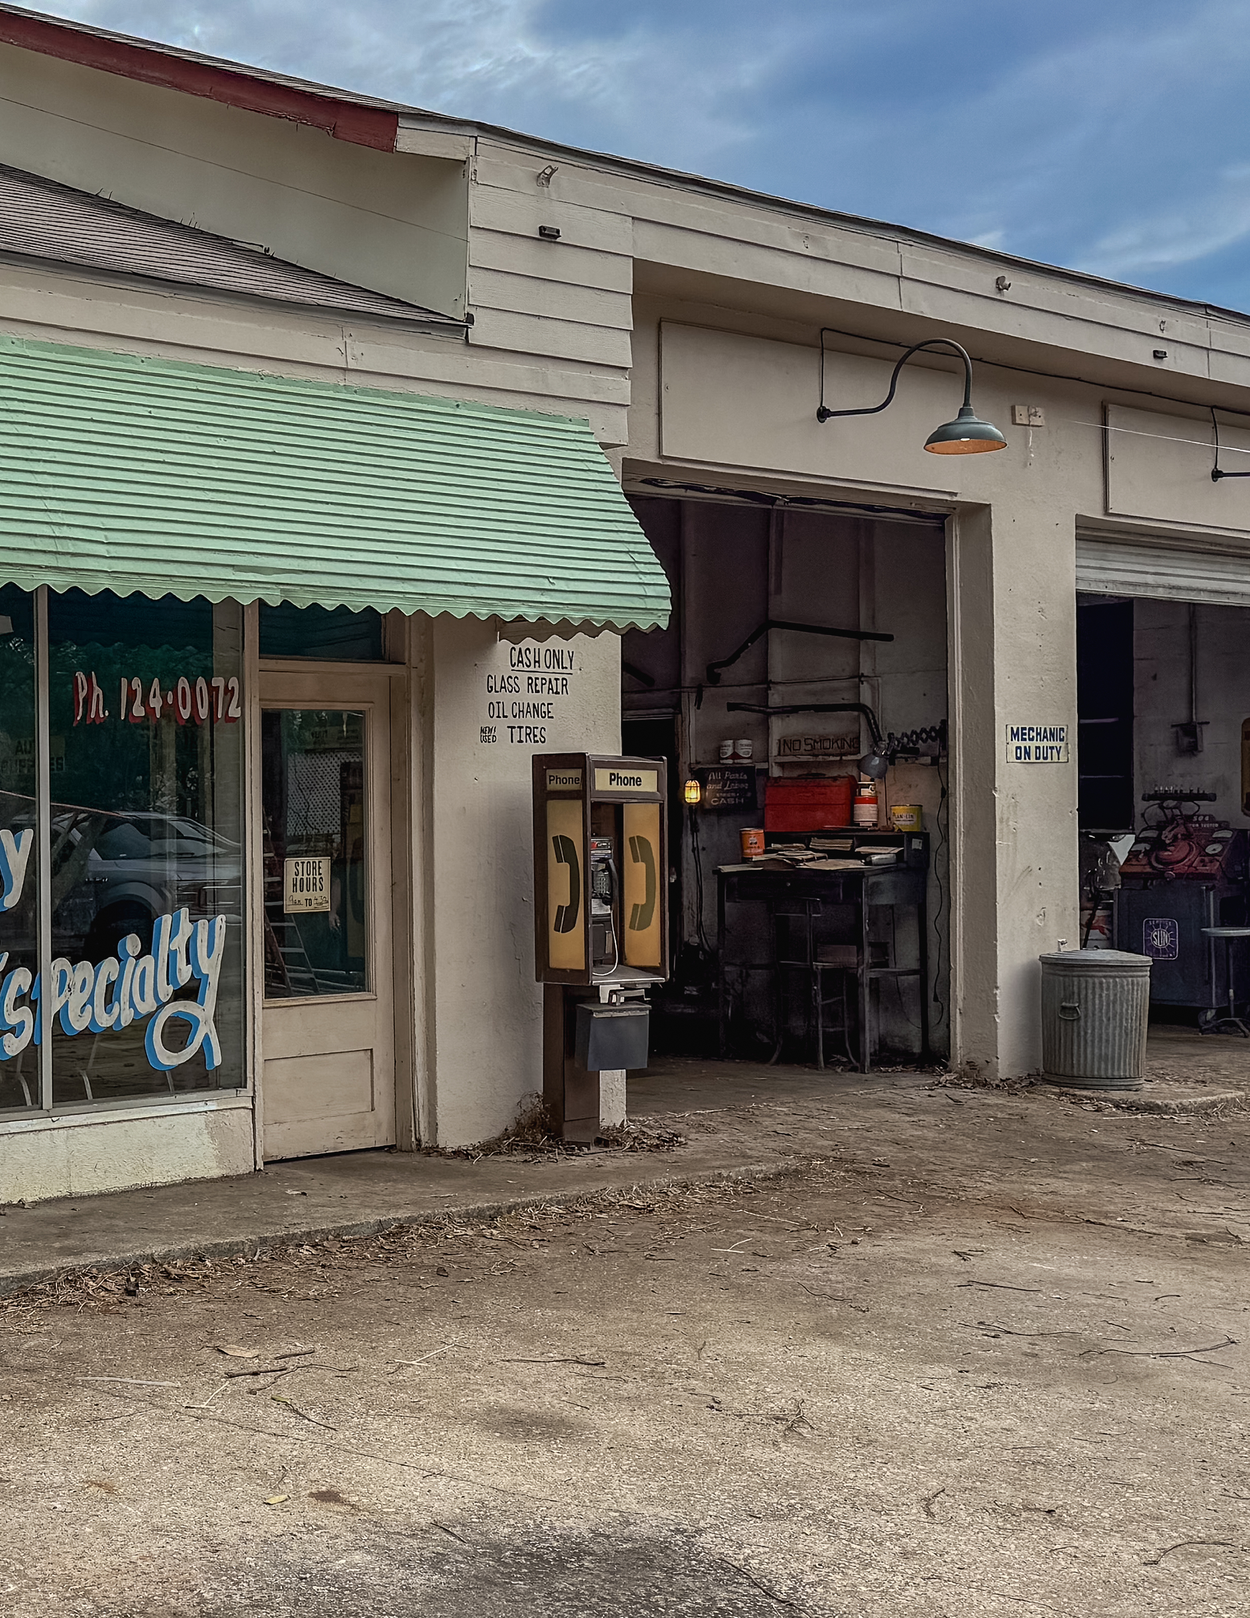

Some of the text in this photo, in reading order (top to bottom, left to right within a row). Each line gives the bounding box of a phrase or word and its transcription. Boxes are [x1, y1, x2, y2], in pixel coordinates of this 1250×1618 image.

[510, 646, 574, 670] CASH ONLY
[487, 674, 569, 695] GLASS REPAIR
[73, 671, 109, 724] Ph.
[488, 701, 555, 719] OIL CHANGE
[480, 726, 546, 744] USED TIRES
[1010, 726, 1065, 742] MECHANIC
[783, 739, 801, 753] NO
[1015, 745, 1062, 761] ON DUTY
[549, 774, 581, 786] Phone
[609, 772, 643, 787] Phone
[710, 797, 744, 806] CASH
[294, 860, 323, 876] STORE
[292, 876, 324, 893] HOURS
[305, 898, 313, 907] TO
